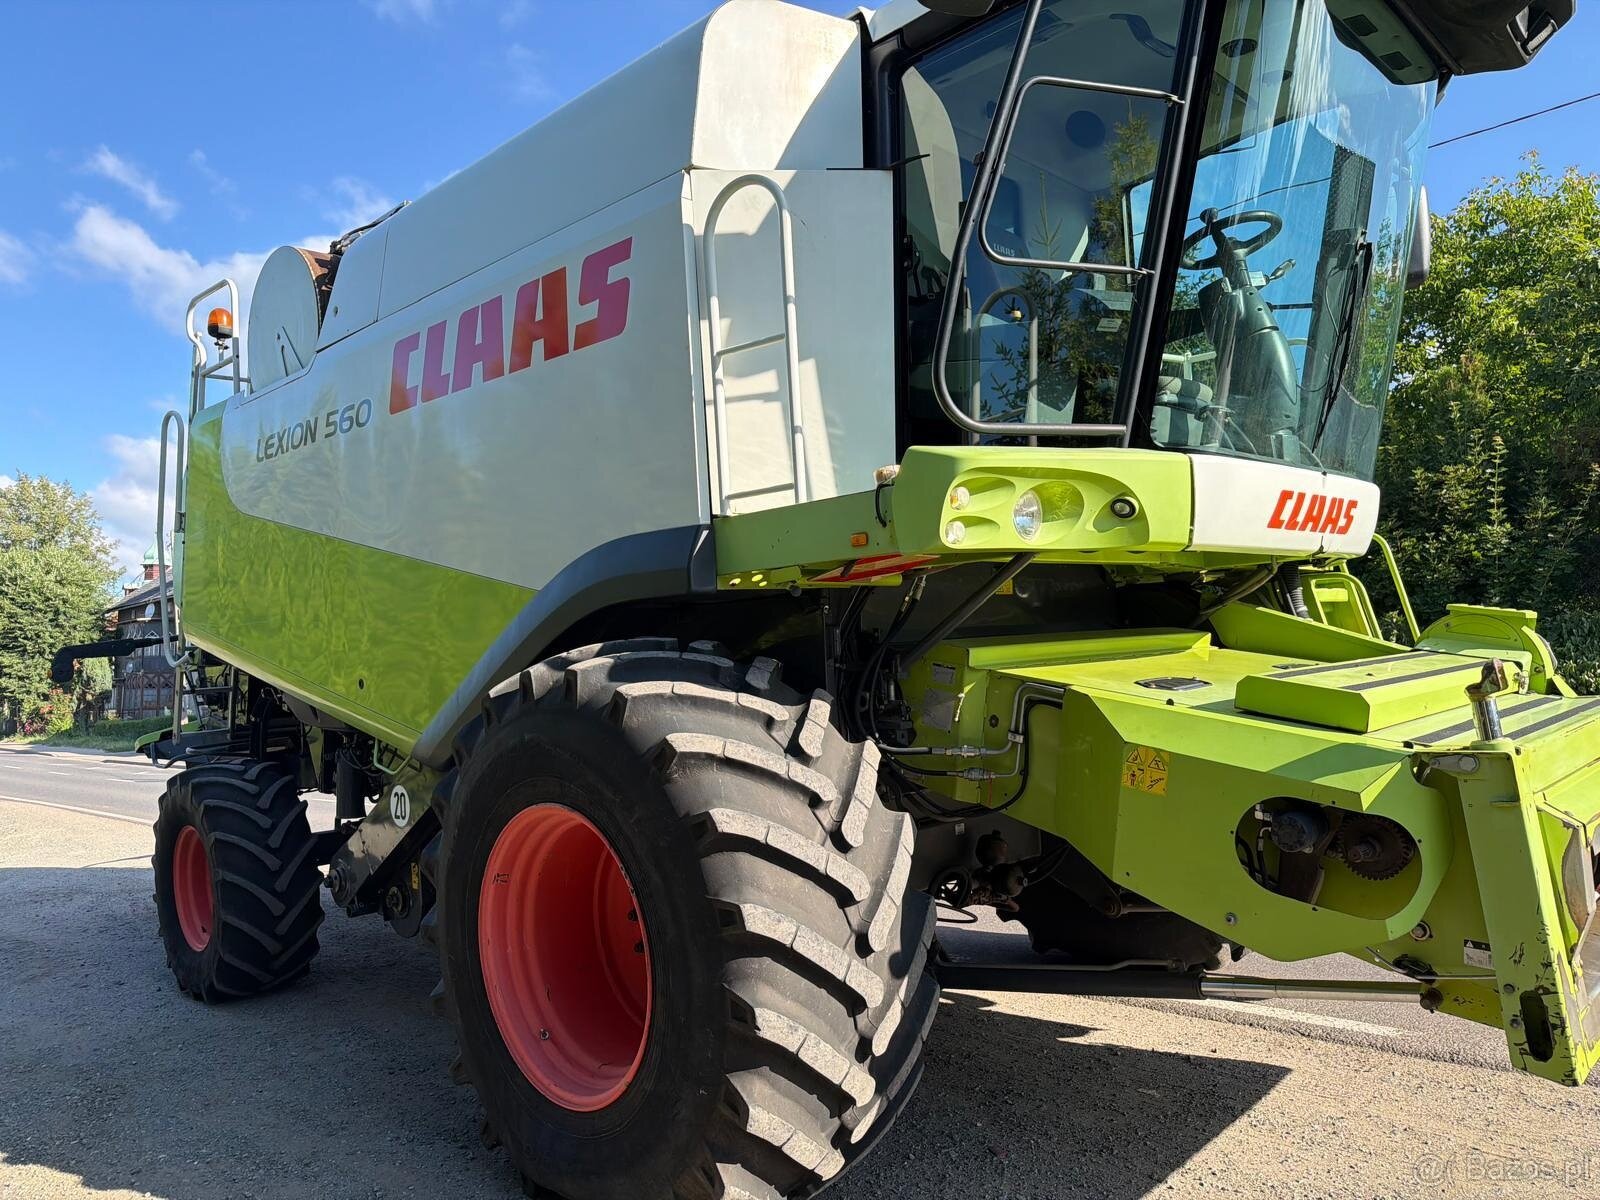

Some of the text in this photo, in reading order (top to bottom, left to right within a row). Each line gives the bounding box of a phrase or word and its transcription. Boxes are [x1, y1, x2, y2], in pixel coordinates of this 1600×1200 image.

[389, 236, 633, 415] CLAAS
[256, 398, 373, 463] LEXION 560
[1266, 489, 1358, 535] CLAAS
[393, 791, 407, 820] 20
